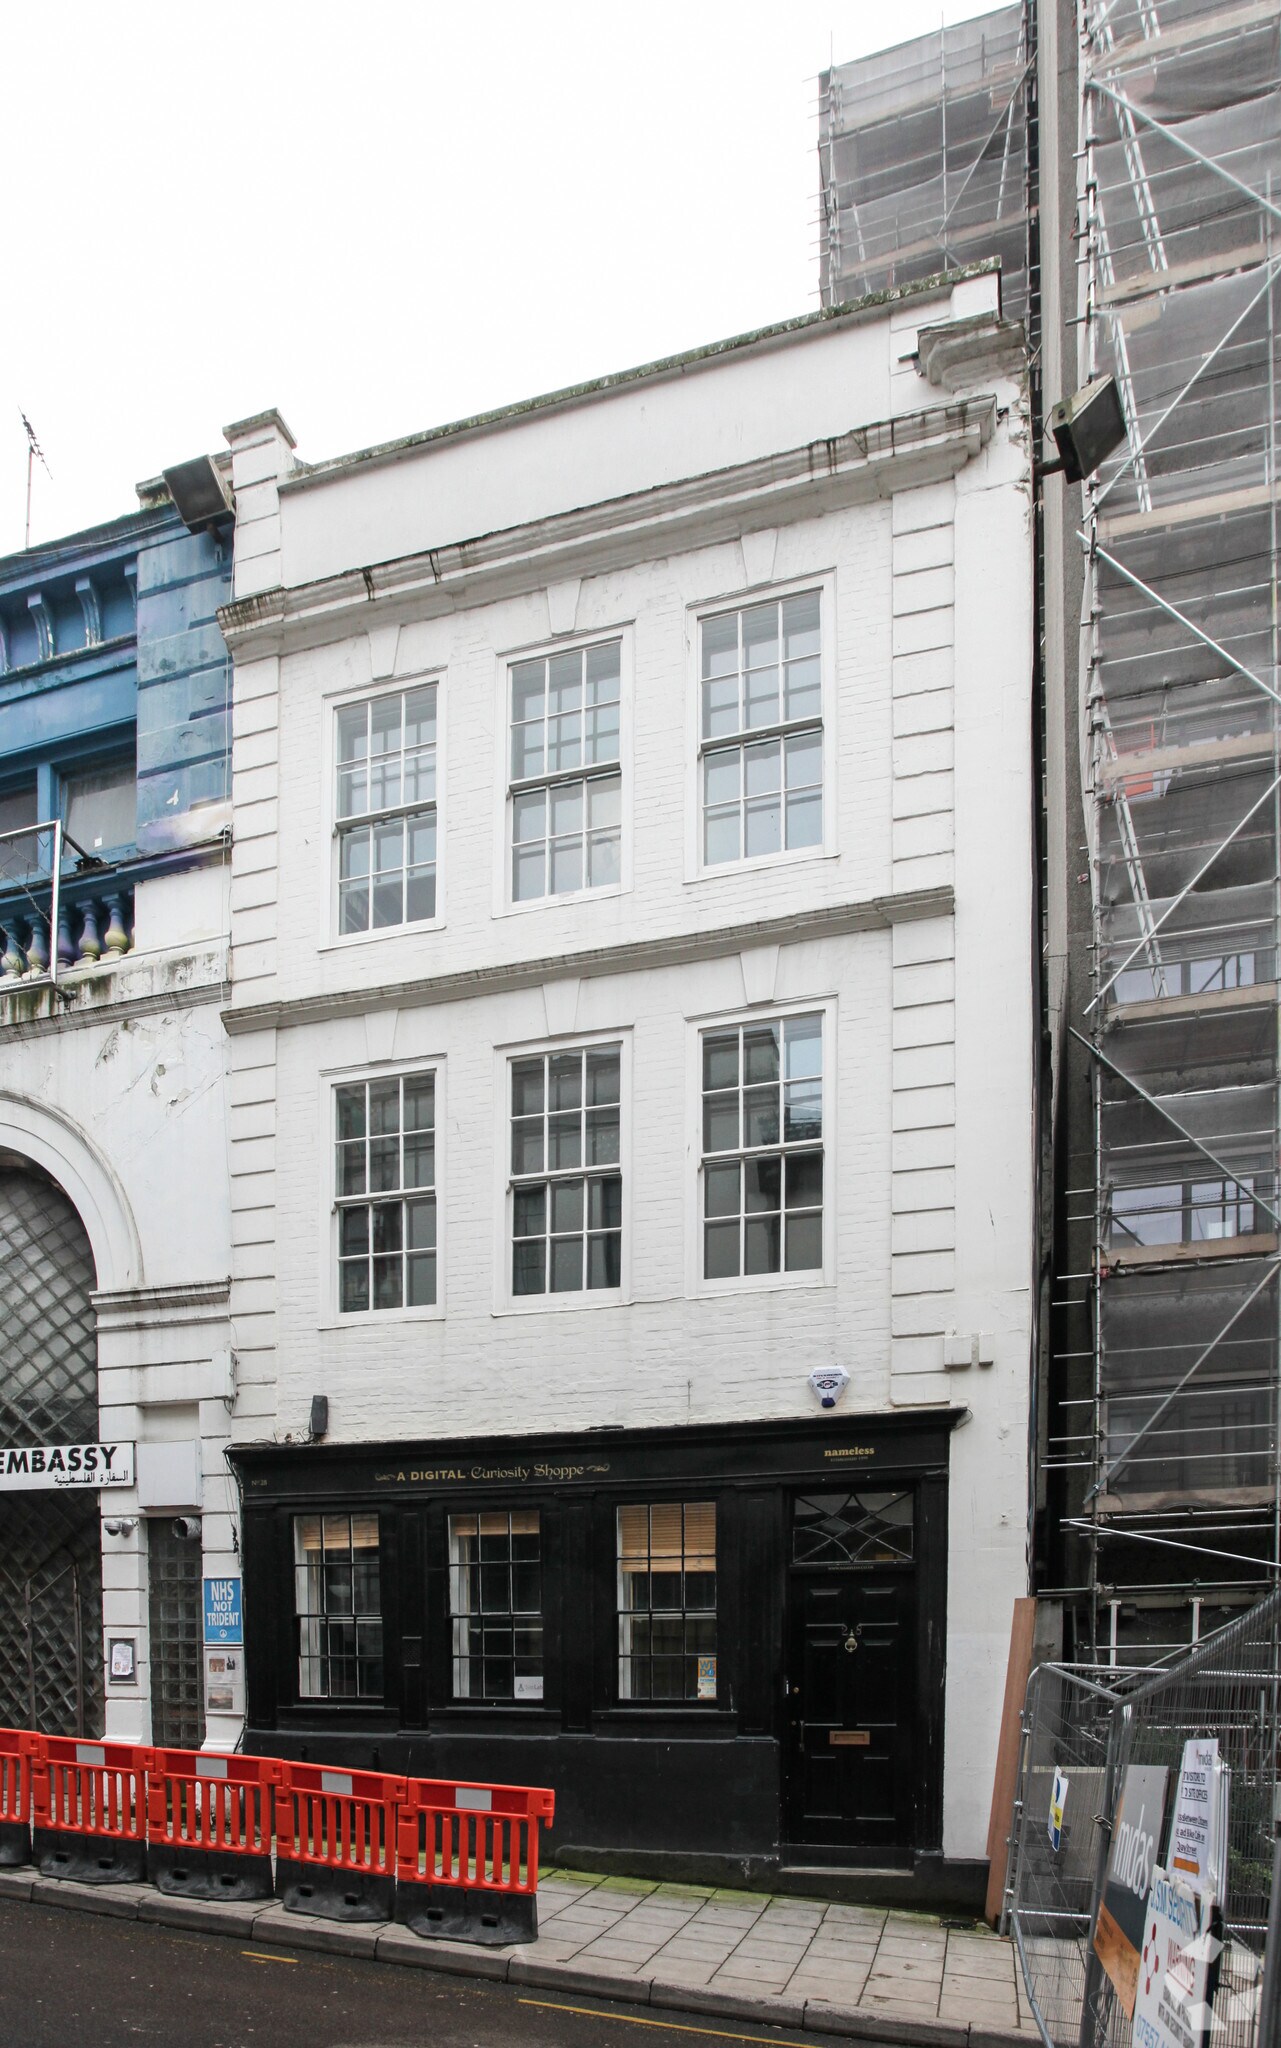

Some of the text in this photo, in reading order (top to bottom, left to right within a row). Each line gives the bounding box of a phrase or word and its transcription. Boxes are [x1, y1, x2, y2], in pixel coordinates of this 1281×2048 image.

[824, 1446, 875, 1457] nameless
[55, 1470, 128, 1486] السفارة الفلسطينية
[396, 1463, 585, 1482] A DIGITAL Curiosity Shoppe
[211, 1581, 234, 1601] NHS
[213, 1601, 233, 1612] NOT
[206, 1612, 240, 1626] TRIDENT
[1113, 1803, 1154, 1900] midas
